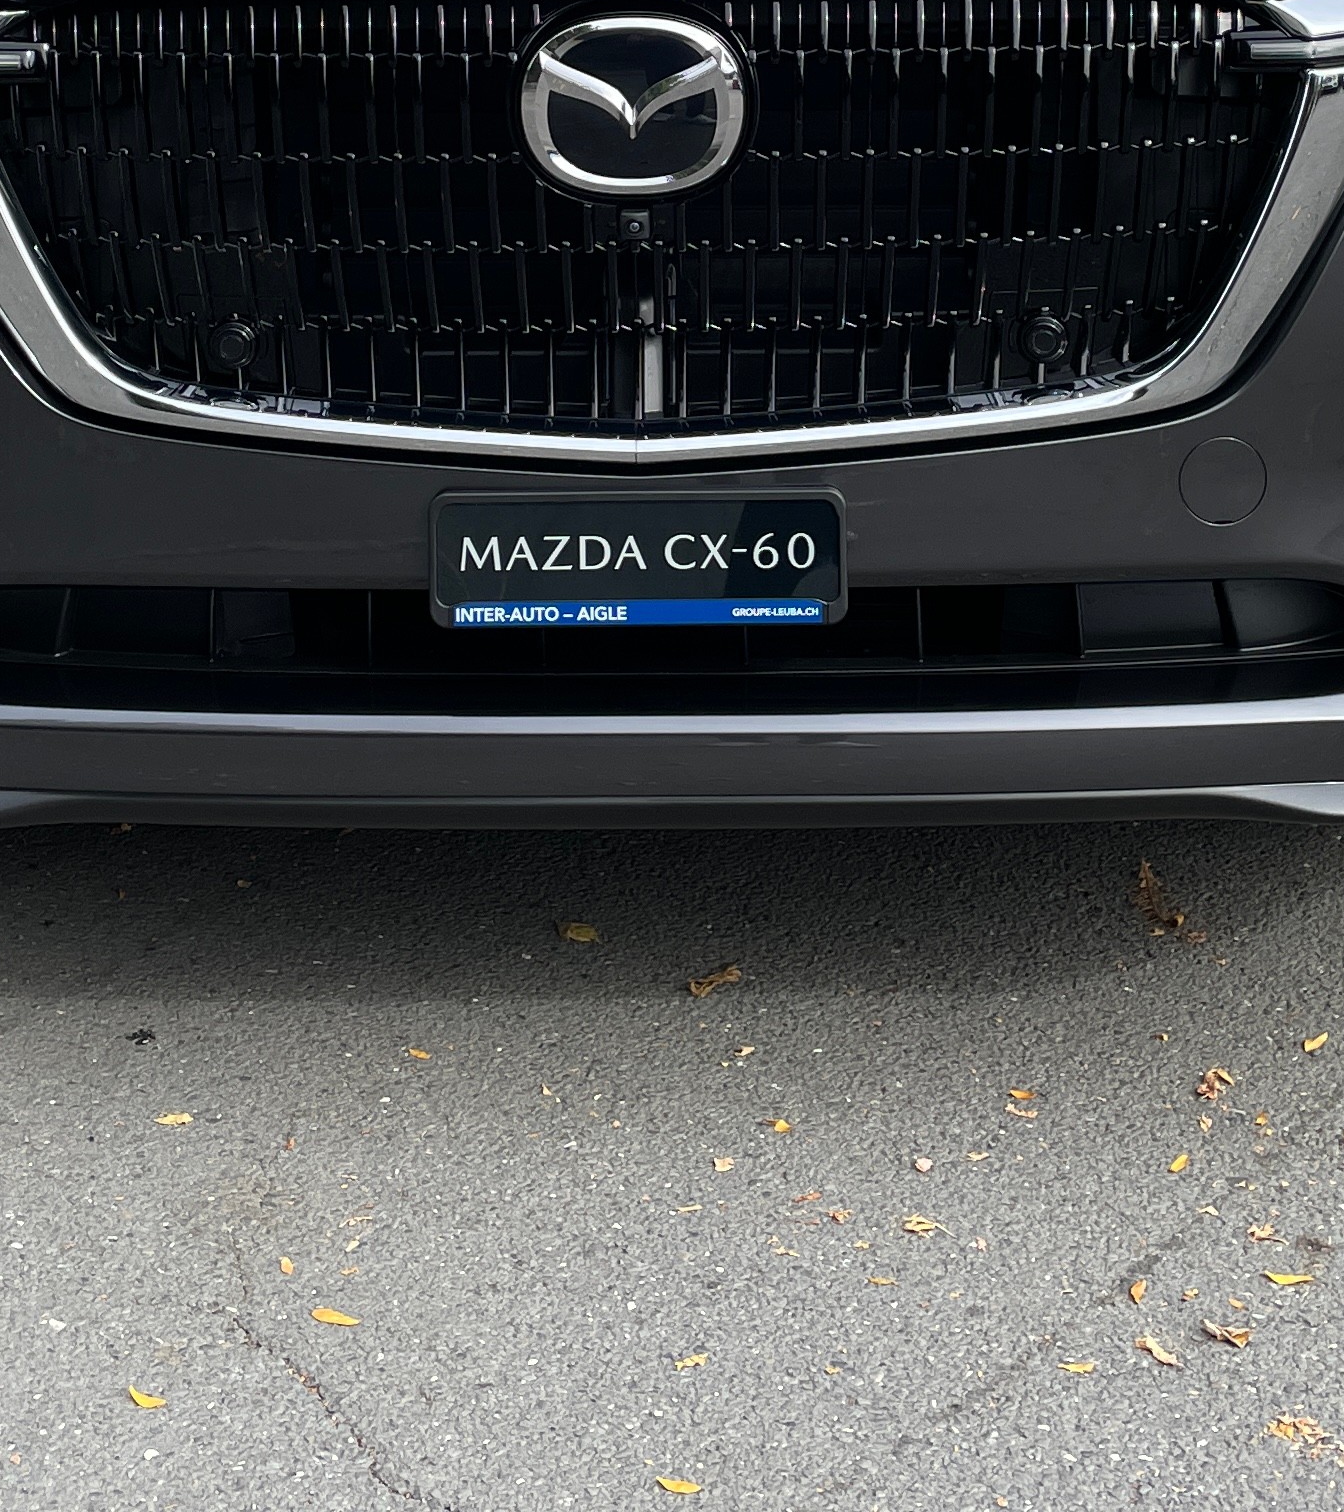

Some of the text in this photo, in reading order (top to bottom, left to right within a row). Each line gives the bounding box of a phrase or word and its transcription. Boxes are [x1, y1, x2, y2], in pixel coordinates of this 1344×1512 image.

[460, 532, 816, 571] MAZDA CX-60
[455, 606, 560, 623] INTER-AUTO
[576, 606, 628, 621] AIGLE
[732, 607, 819, 617] GROUPE-LEUBA.CH
